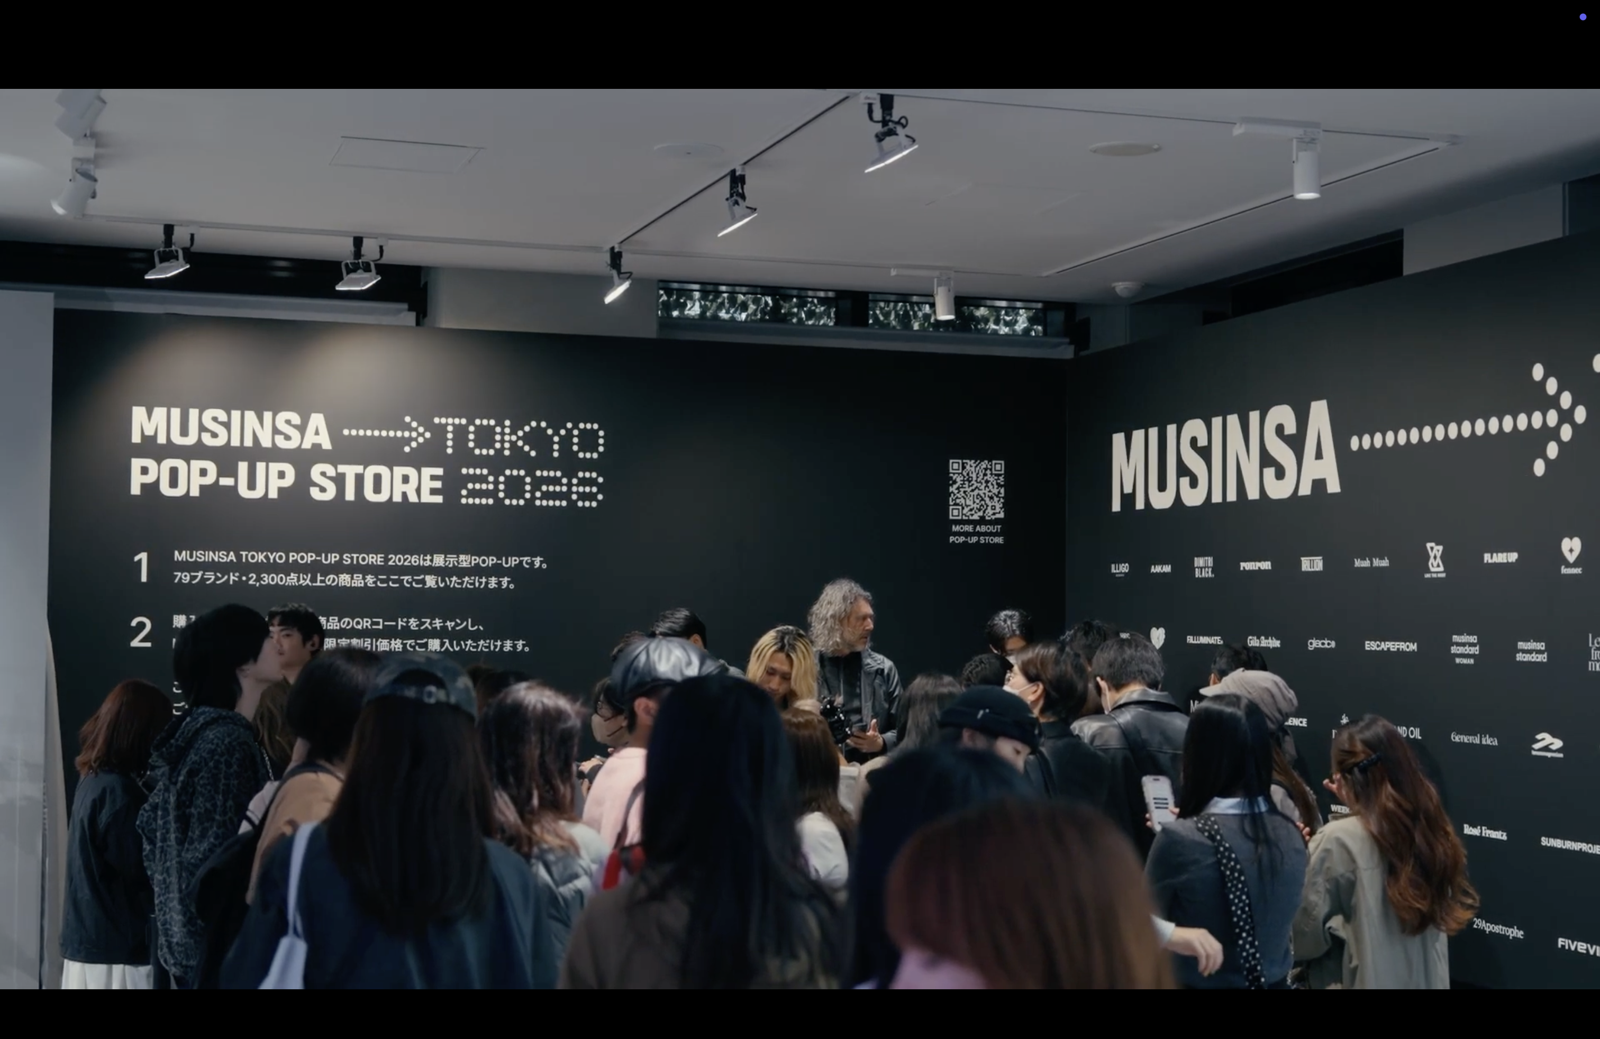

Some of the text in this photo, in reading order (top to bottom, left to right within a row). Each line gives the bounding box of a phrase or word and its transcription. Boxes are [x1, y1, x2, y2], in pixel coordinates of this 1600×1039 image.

[131, 405, 606, 459] MUSINSA TOKYO
[1111, 399, 1341, 513] MUSINSA
[130, 457, 604, 507] POP-UP STORE 2026
[952, 524, 1002, 533] MORE ABOUT
[949, 535, 1004, 544] POP-UP STORE
[174, 550, 236, 562] MUSINSA
[240, 551, 286, 564] TOKYO
[289, 552, 339, 565] POP-UP
[343, 553, 385, 566] STORE
[133, 551, 149, 583] 1
[130, 616, 152, 647] 2
[1452, 633, 1478, 643] musinsa
[1364, 640, 1418, 652] ESCAPEFROM
[1450, 644, 1480, 655] standard
[1517, 639, 1546, 650] musinsa
[1455, 657, 1475, 665] WOMAN
[1515, 651, 1548, 662] standard
[1408, 726, 1422, 740] OIL
[1450, 731, 1499, 746] General idea
[1473, 917, 1525, 940] 29Apostrophe
